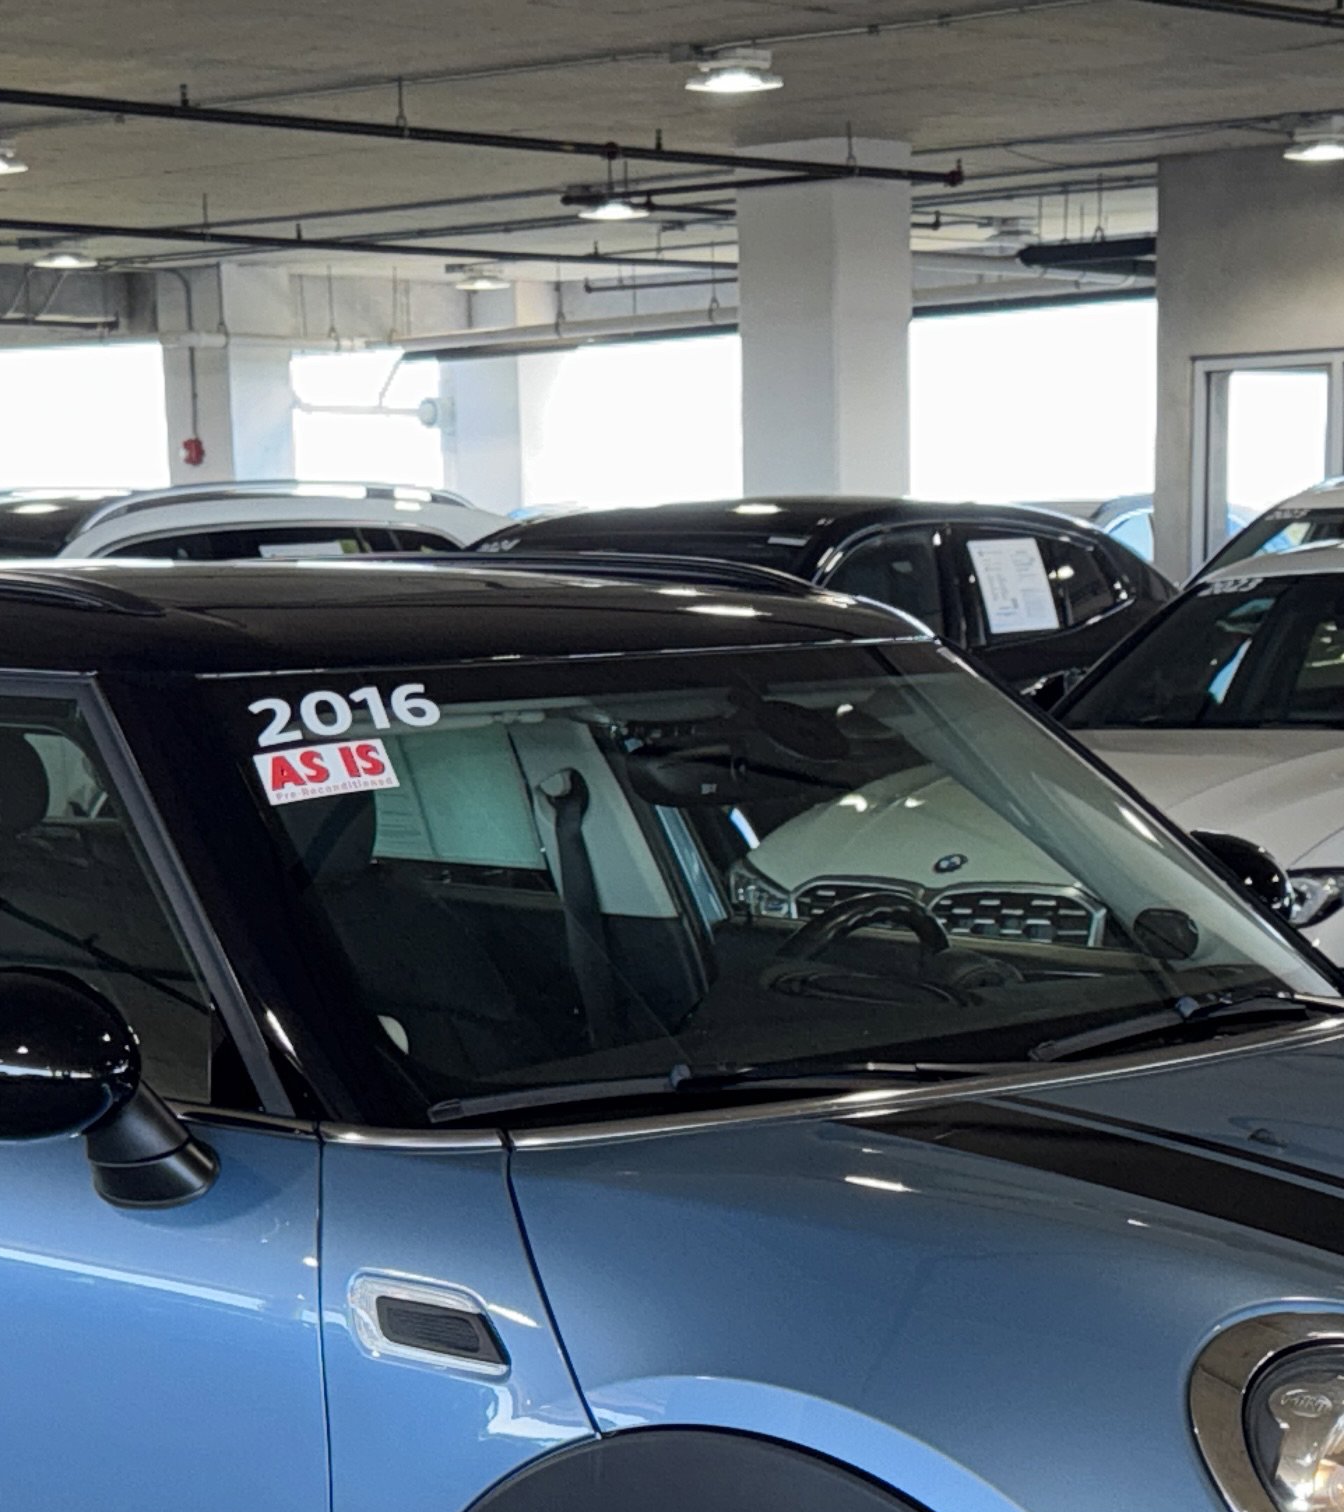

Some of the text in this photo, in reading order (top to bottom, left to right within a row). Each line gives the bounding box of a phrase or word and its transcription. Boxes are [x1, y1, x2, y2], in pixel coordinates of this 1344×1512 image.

[248, 683, 441, 747] 2016
[270, 743, 386, 792] AS IS
